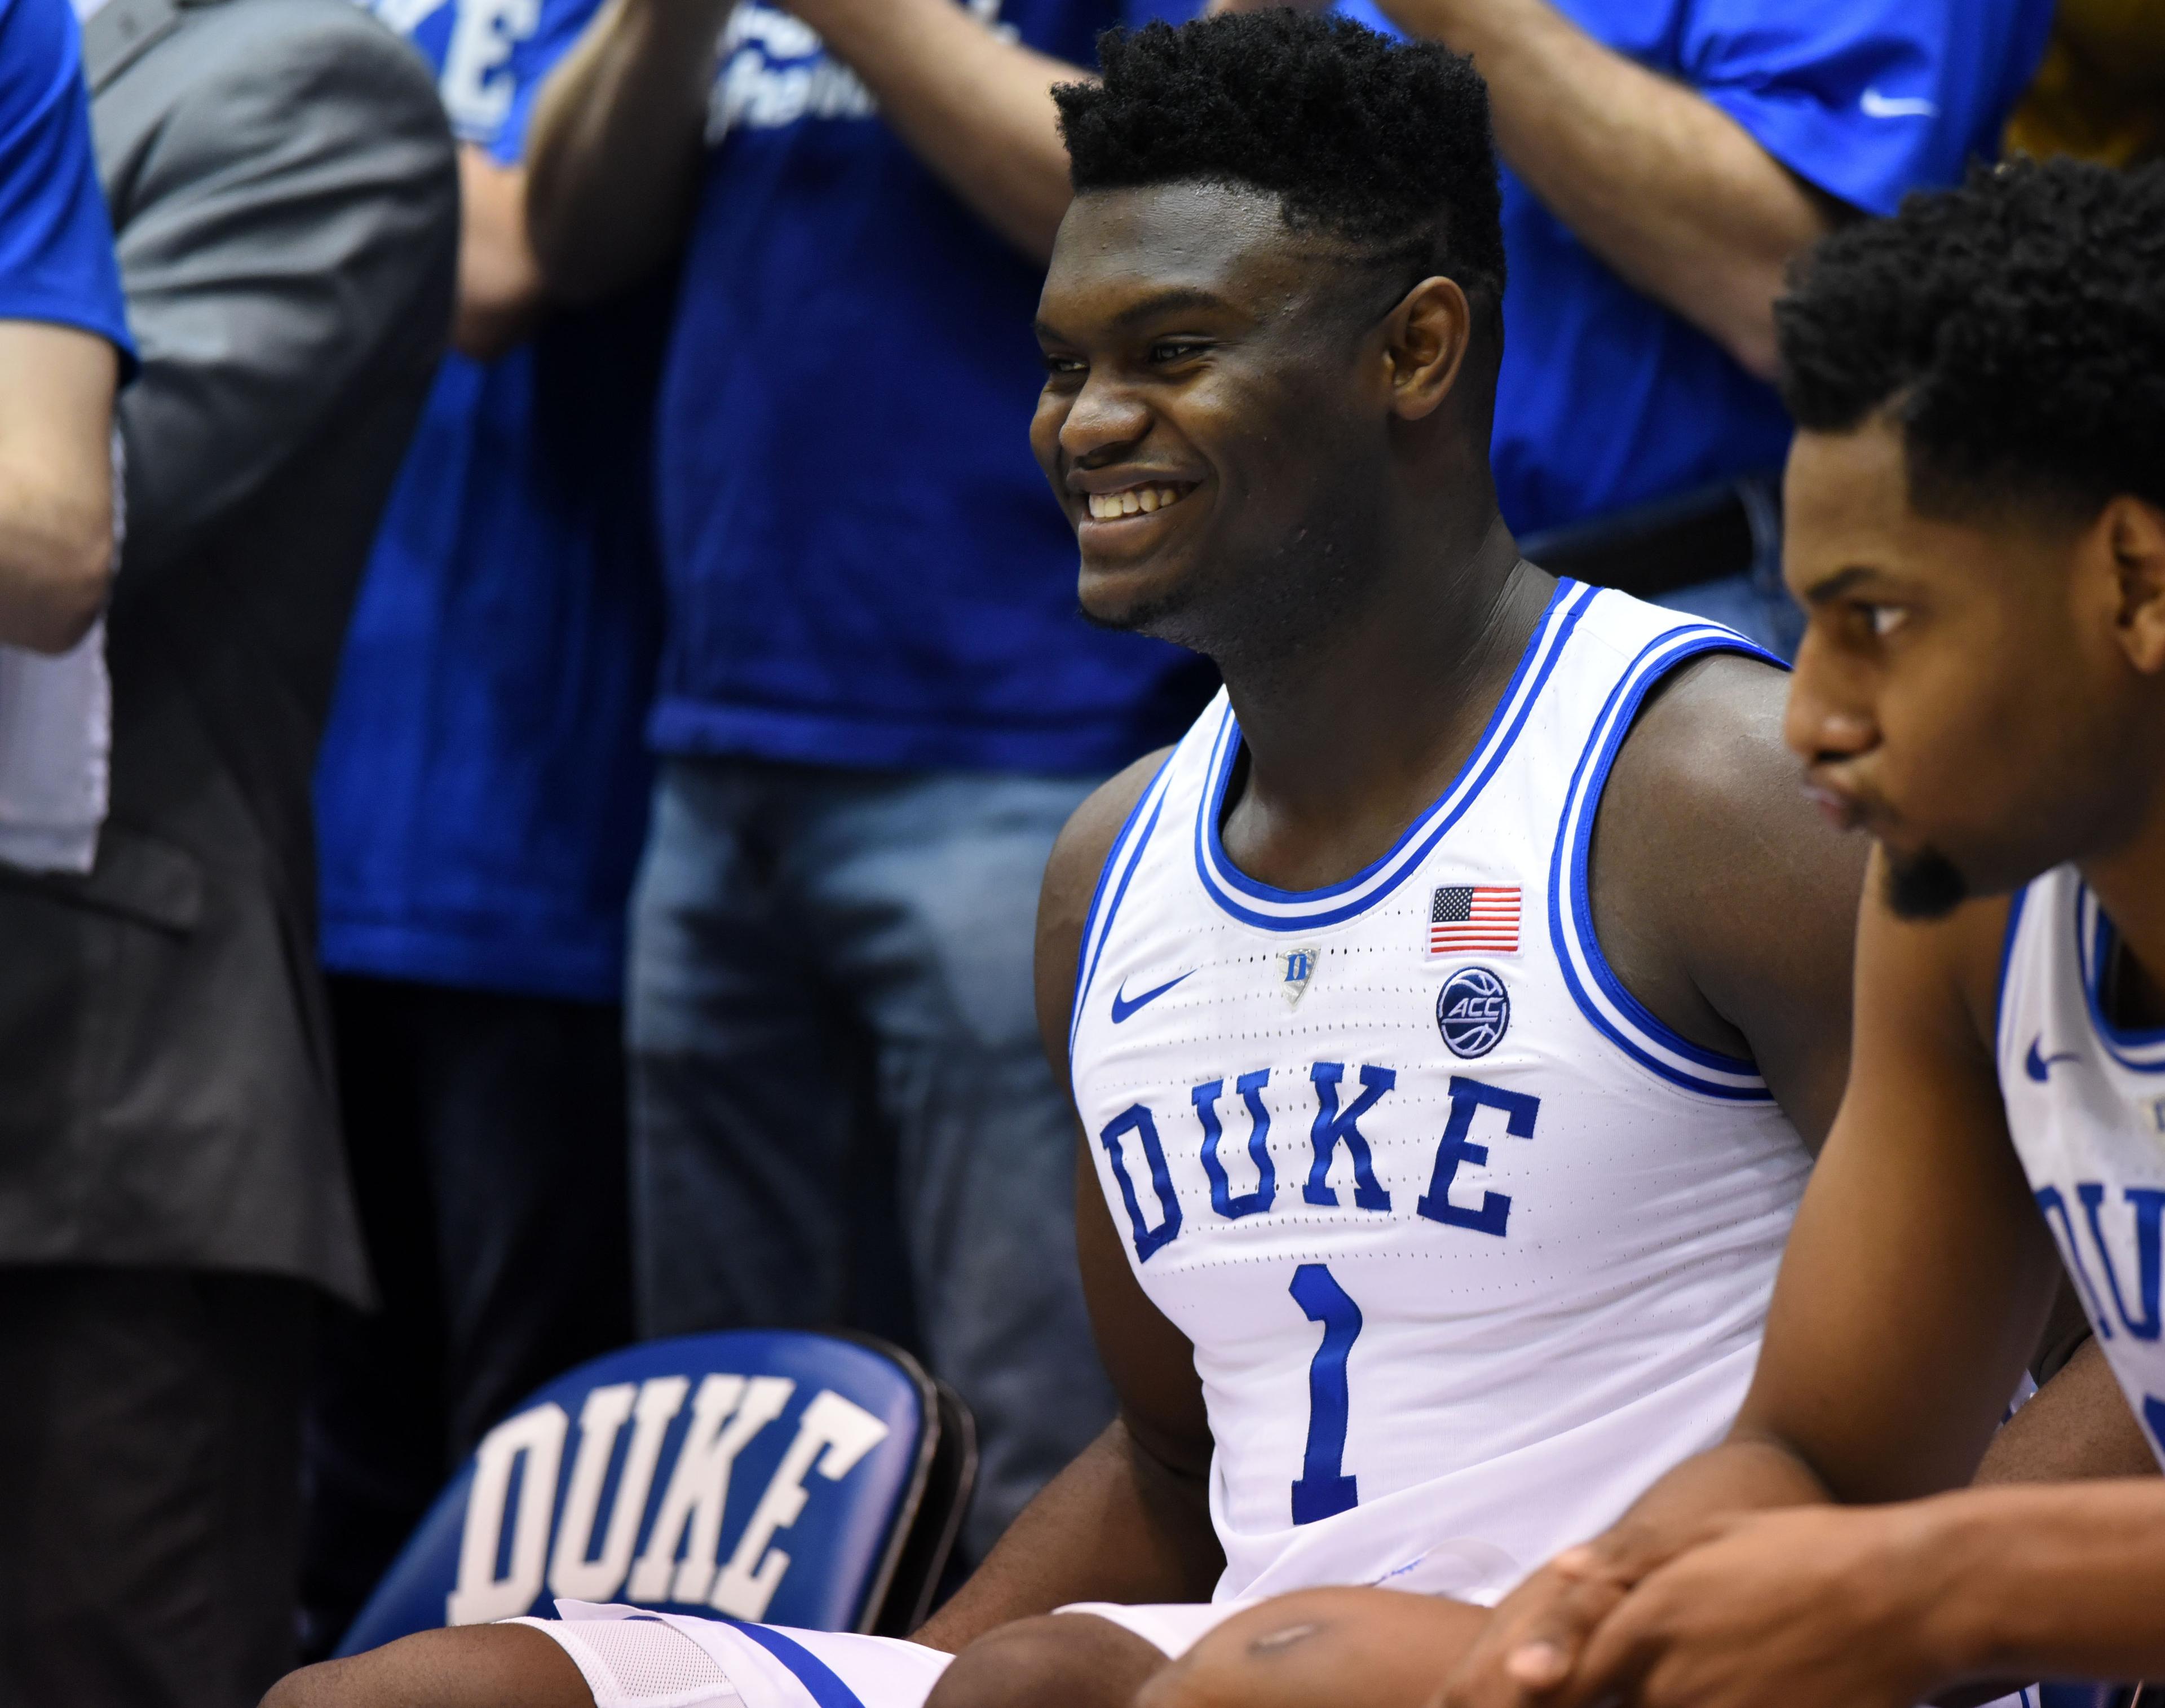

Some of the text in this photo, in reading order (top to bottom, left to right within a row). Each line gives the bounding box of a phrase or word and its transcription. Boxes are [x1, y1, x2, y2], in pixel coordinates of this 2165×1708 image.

[1448, 997, 1505, 1018] ACC
[1100, 1062, 1540, 1263] DUKE
[447, 1372, 890, 1626] DUKE
[1288, 1264, 1363, 1525] 1
